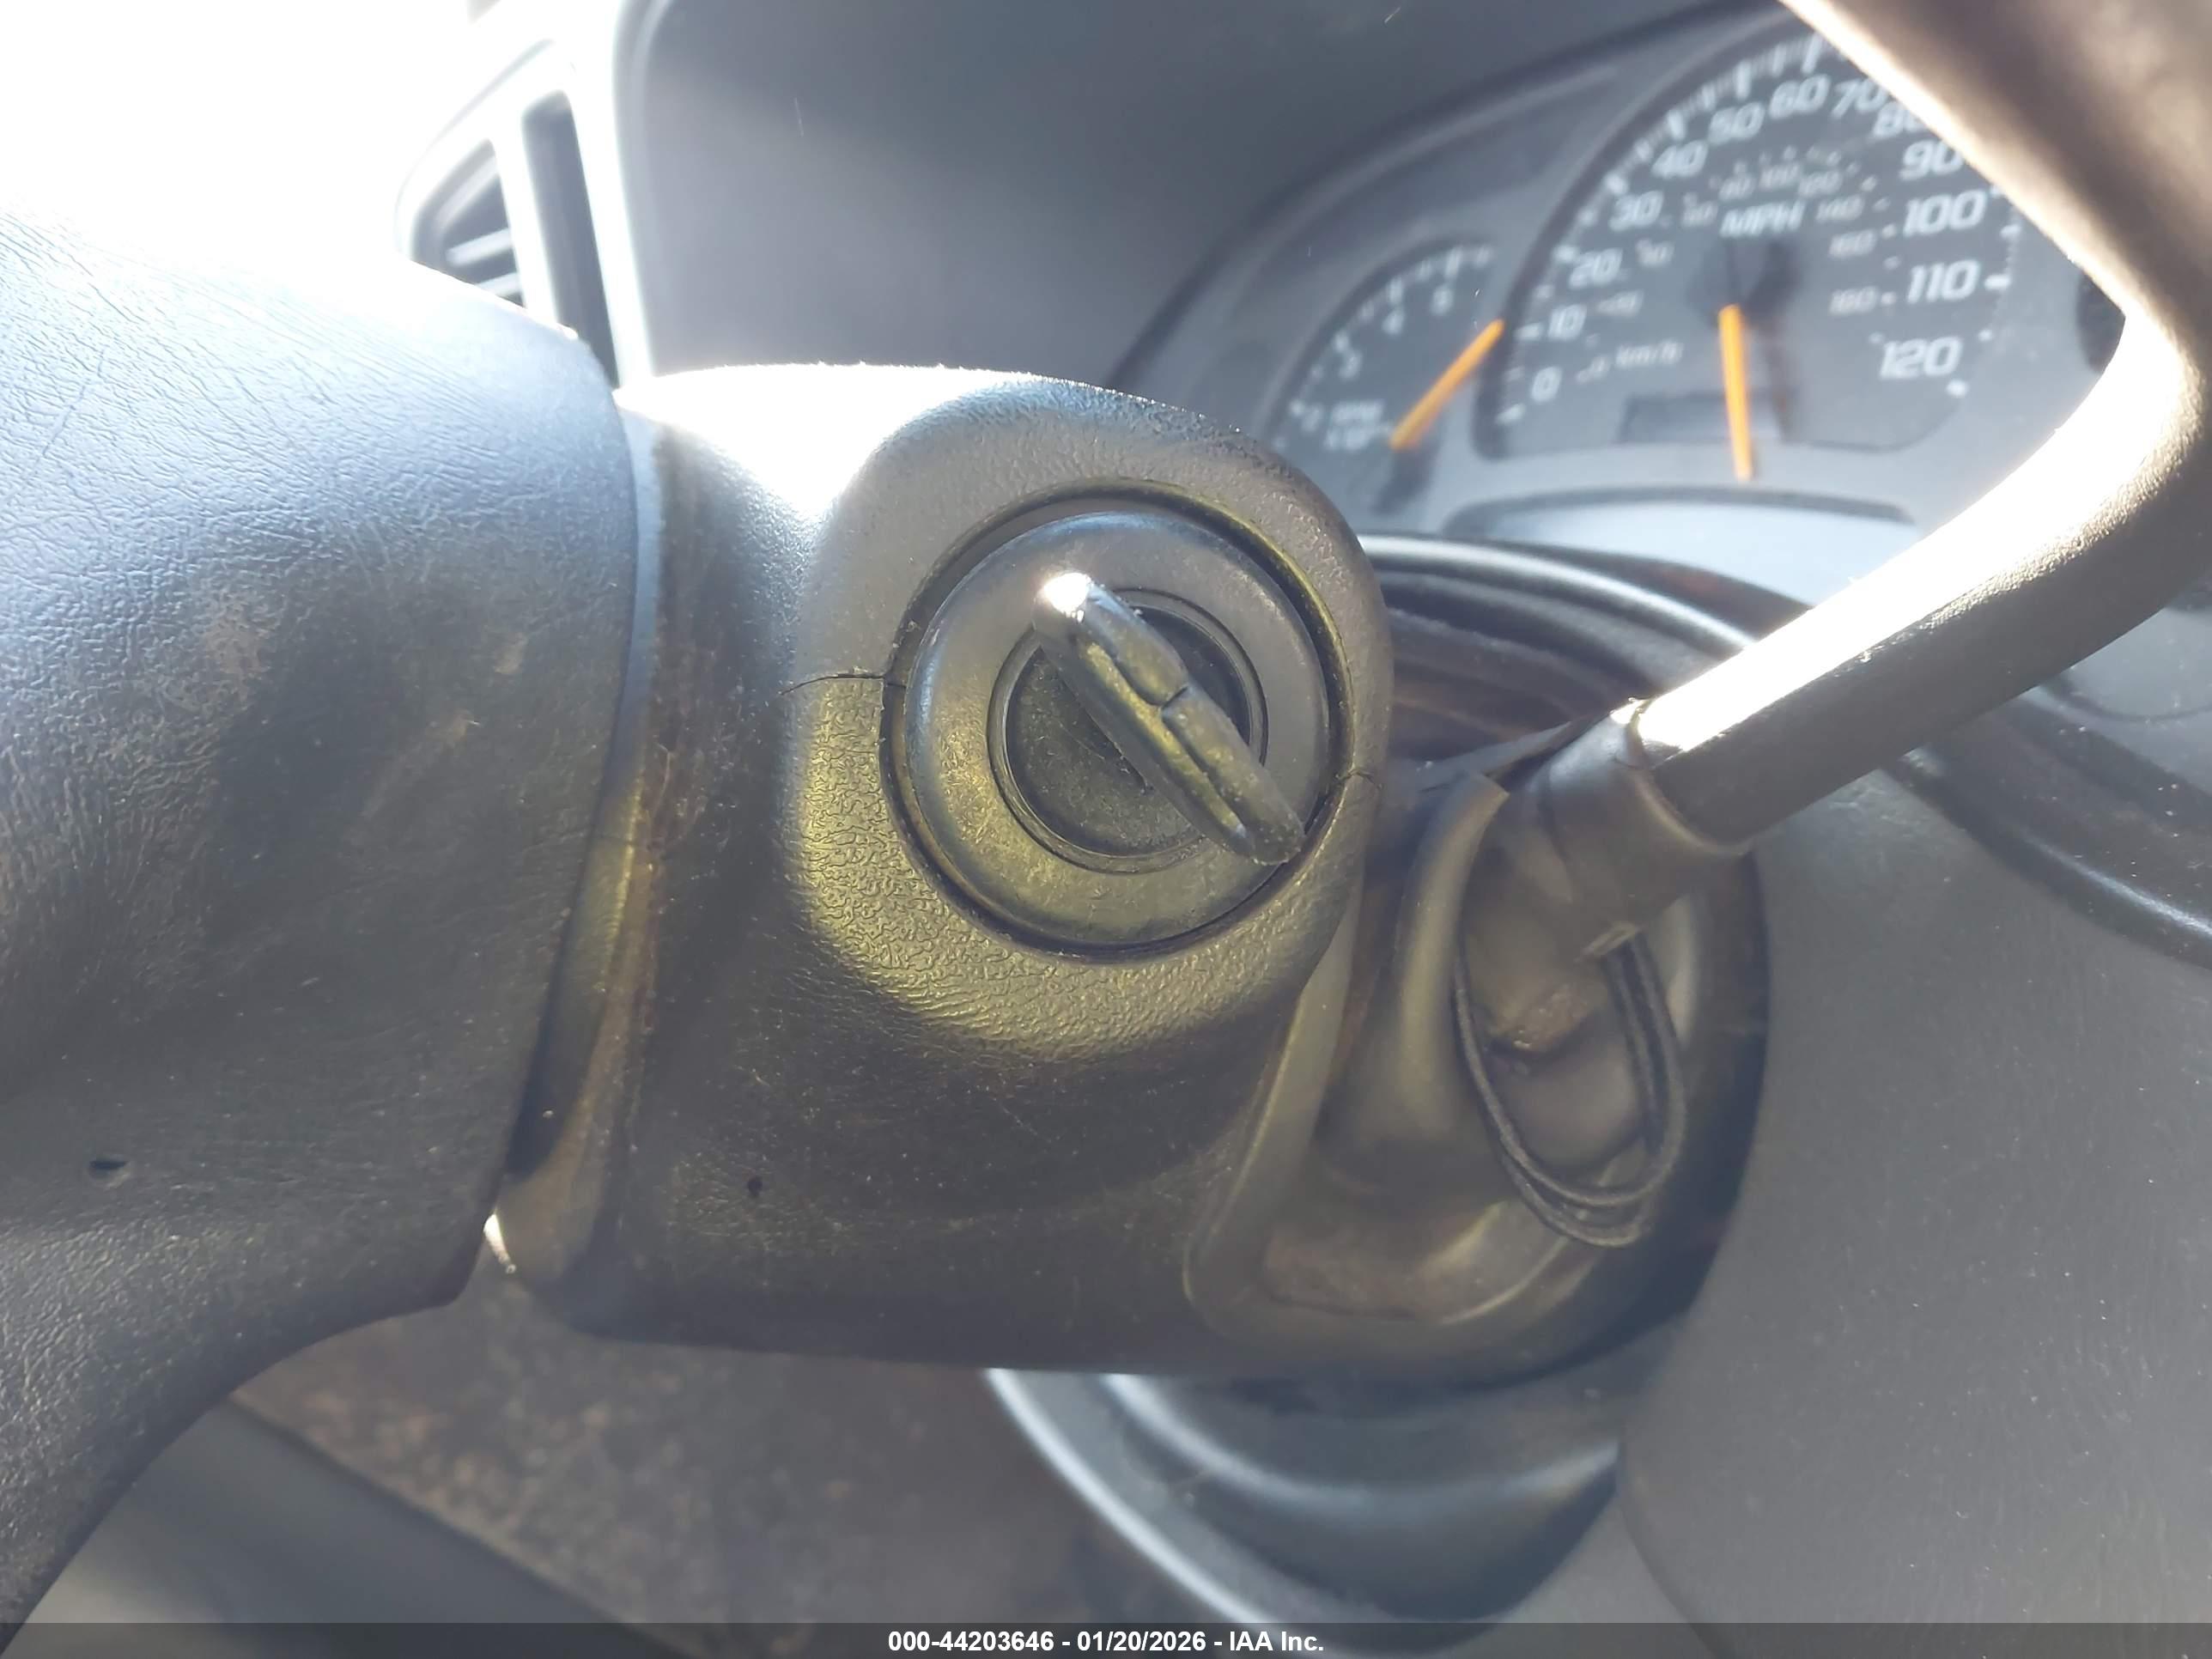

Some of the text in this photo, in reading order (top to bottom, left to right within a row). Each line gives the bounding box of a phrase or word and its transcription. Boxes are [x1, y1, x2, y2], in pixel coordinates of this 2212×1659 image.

[1769, 75, 1831, 119] 60
[1831, 78, 1888, 118] 70
[1708, 102, 1765, 145] 50
[1650, 140, 1709, 179] 40
[1899, 138, 1965, 181] 90
[1608, 190, 1664, 231] 30
[1719, 201, 1807, 237] MPH
[1903, 189, 1987, 238] 100
[1568, 247, 1623, 289] 20
[1906, 260, 1979, 305] 110
[1547, 304, 1588, 340] 10
[1880, 336, 1963, 380] 120
[1531, 366, 1563, 403] 0
